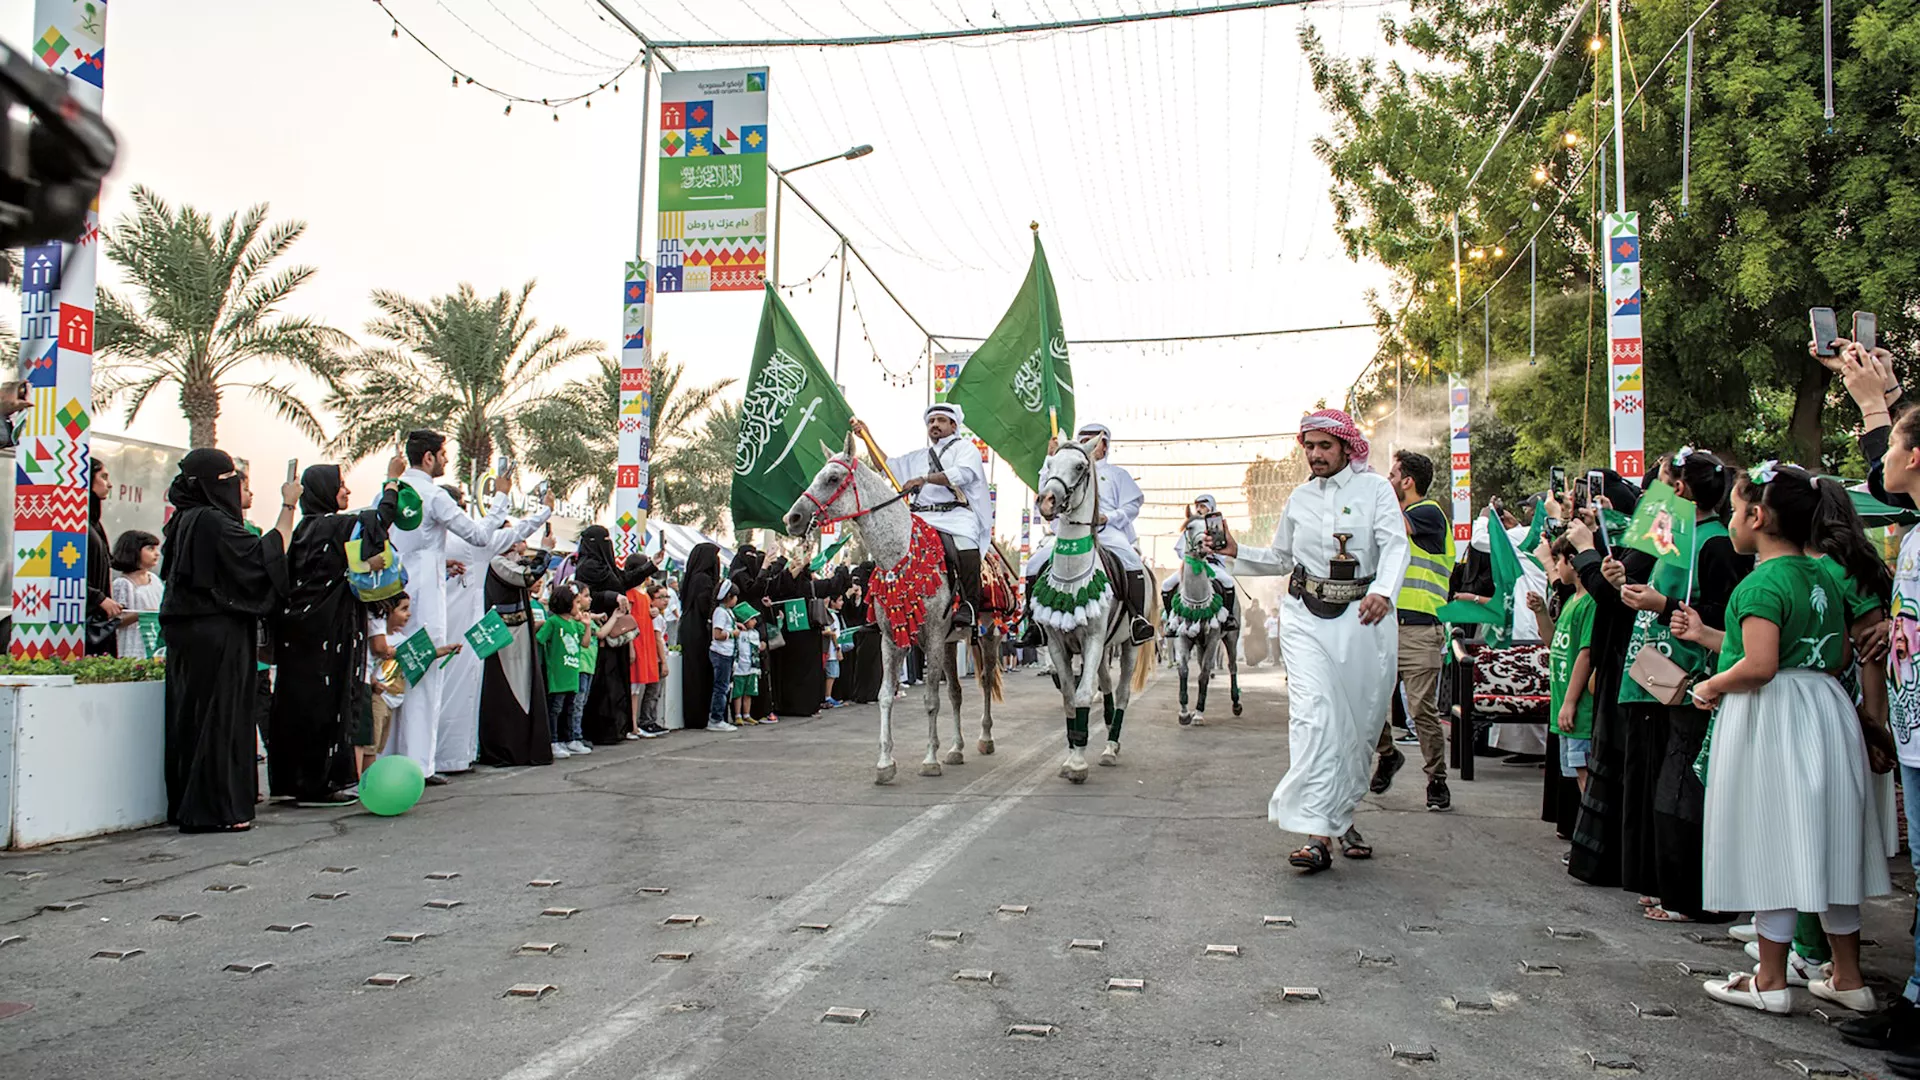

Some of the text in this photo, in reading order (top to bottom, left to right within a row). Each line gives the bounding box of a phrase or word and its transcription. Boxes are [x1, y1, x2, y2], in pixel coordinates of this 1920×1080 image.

[687, 217, 749, 231] دام عزك يا وطن
[119, 484, 143, 503] PIN
[552, 498, 596, 522] URGER
